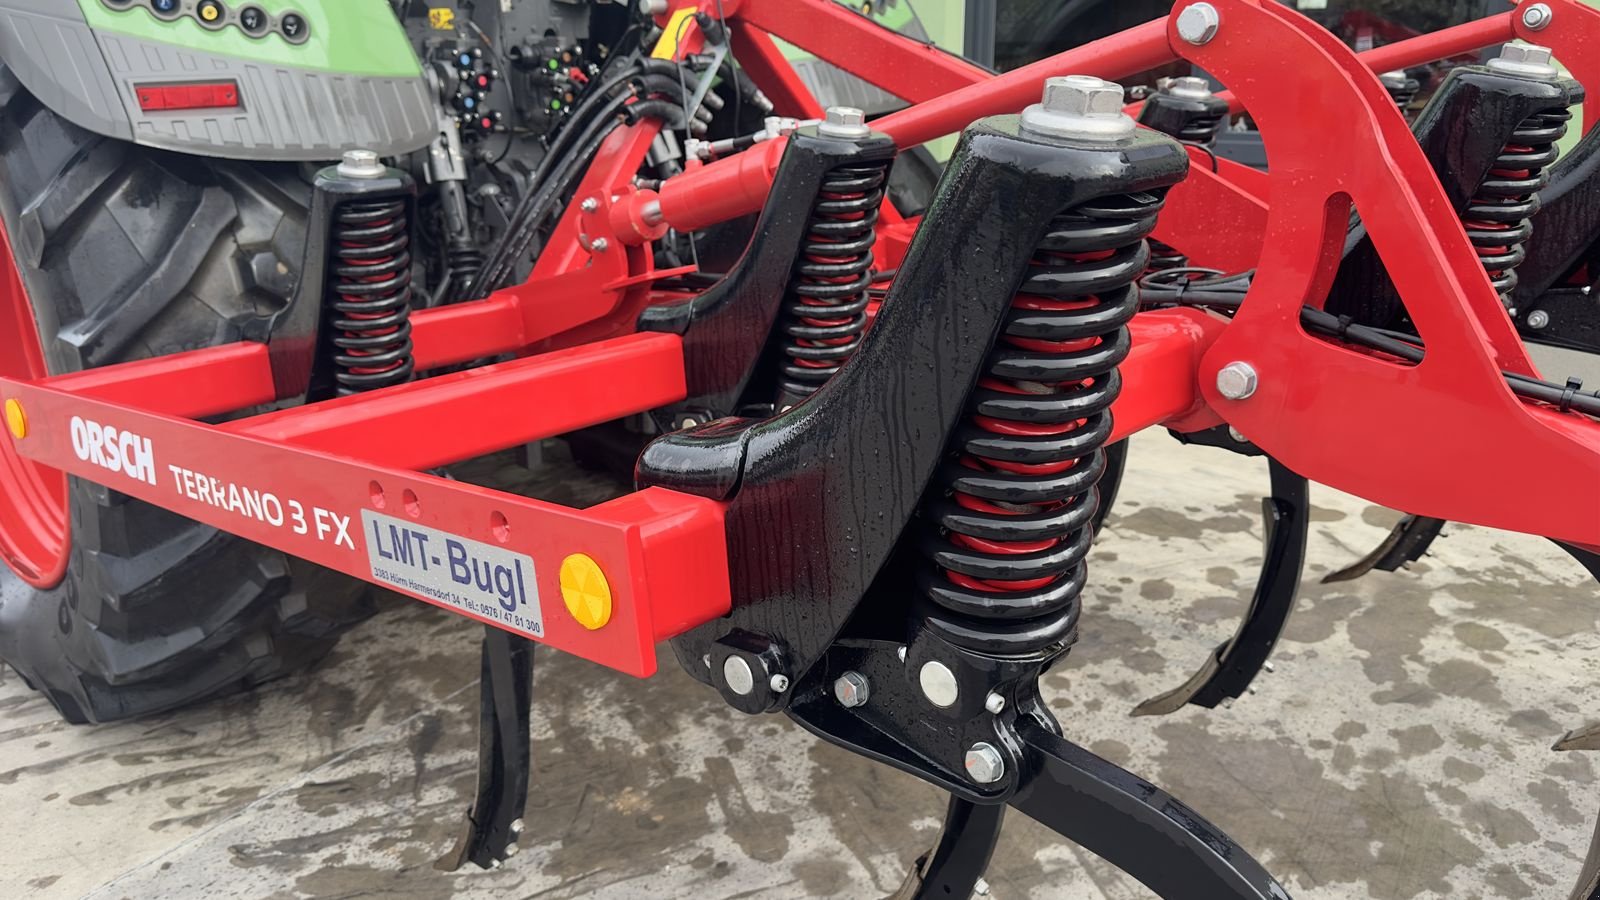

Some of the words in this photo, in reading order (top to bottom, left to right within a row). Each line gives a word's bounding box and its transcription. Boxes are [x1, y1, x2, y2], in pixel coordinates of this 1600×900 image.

[168, 464, 283, 527] TERRANO
[288, 500, 307, 534] 3
[313, 507, 355, 550] FX
[451, 593, 461, 605] 34
[504, 611, 513, 623] 47
[514, 615, 524, 627] 81
[526, 619, 541, 633] 300
